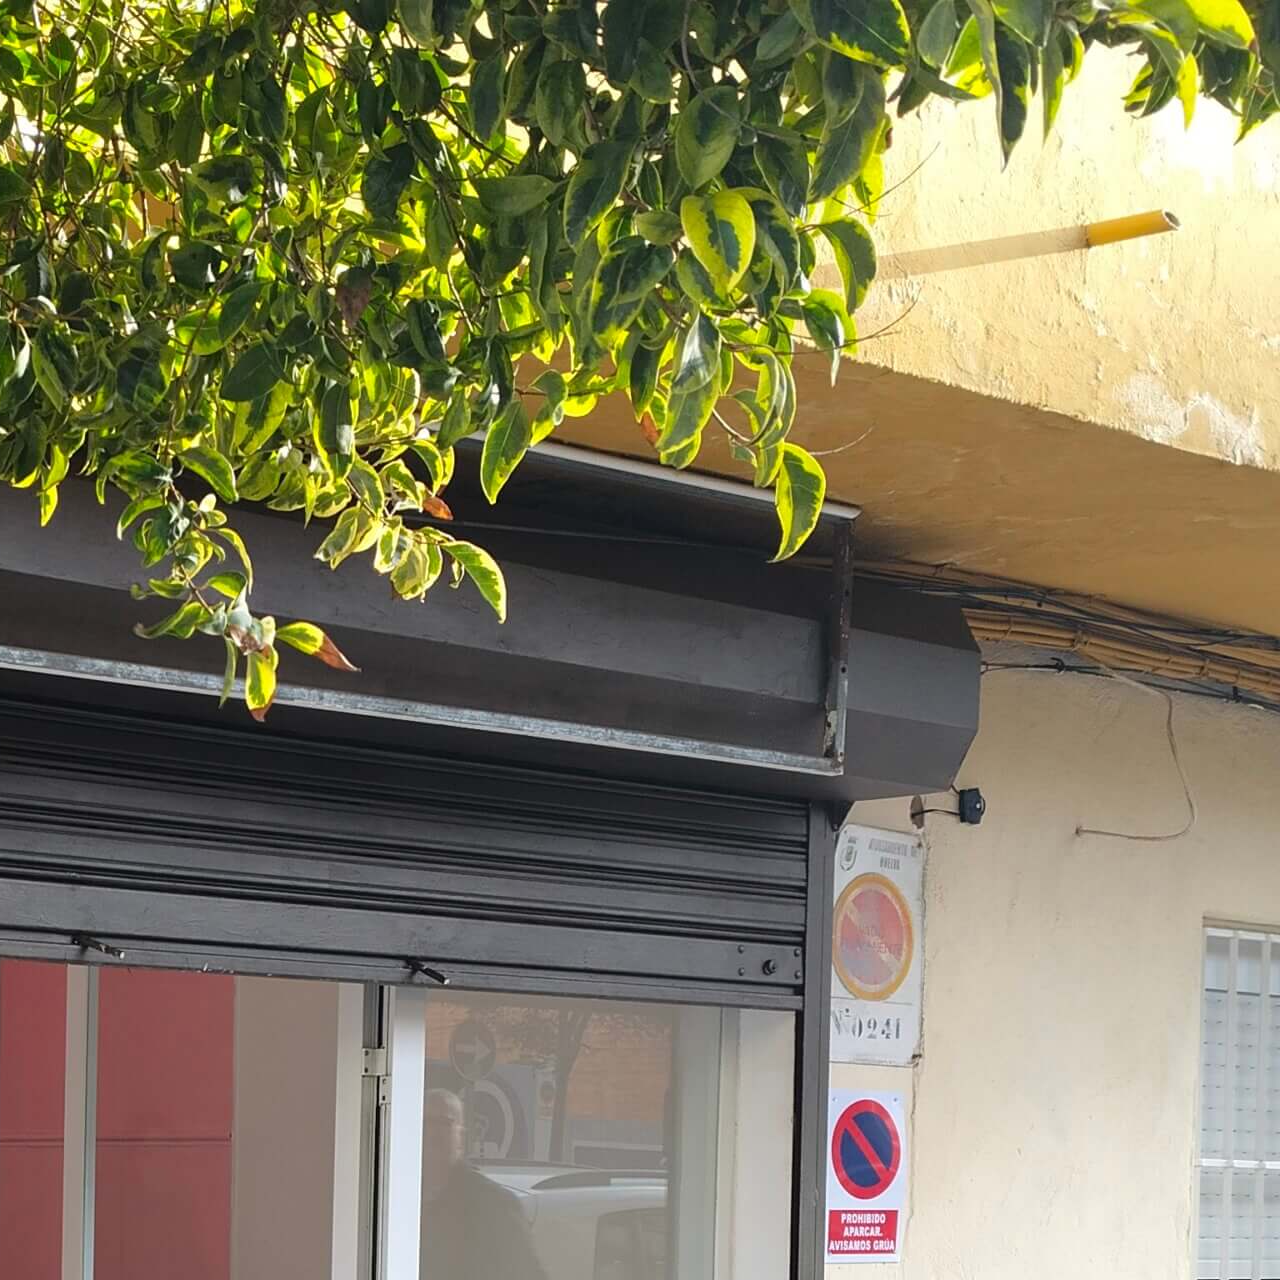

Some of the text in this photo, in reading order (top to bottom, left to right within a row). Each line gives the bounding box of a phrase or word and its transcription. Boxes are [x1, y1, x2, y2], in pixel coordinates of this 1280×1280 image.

[841, 1213, 886, 1224] PROHIBIDO
[843, 1226, 883, 1237] APARCAR.
[829, 1238, 894, 1251] AVISAMOS GRÚA
